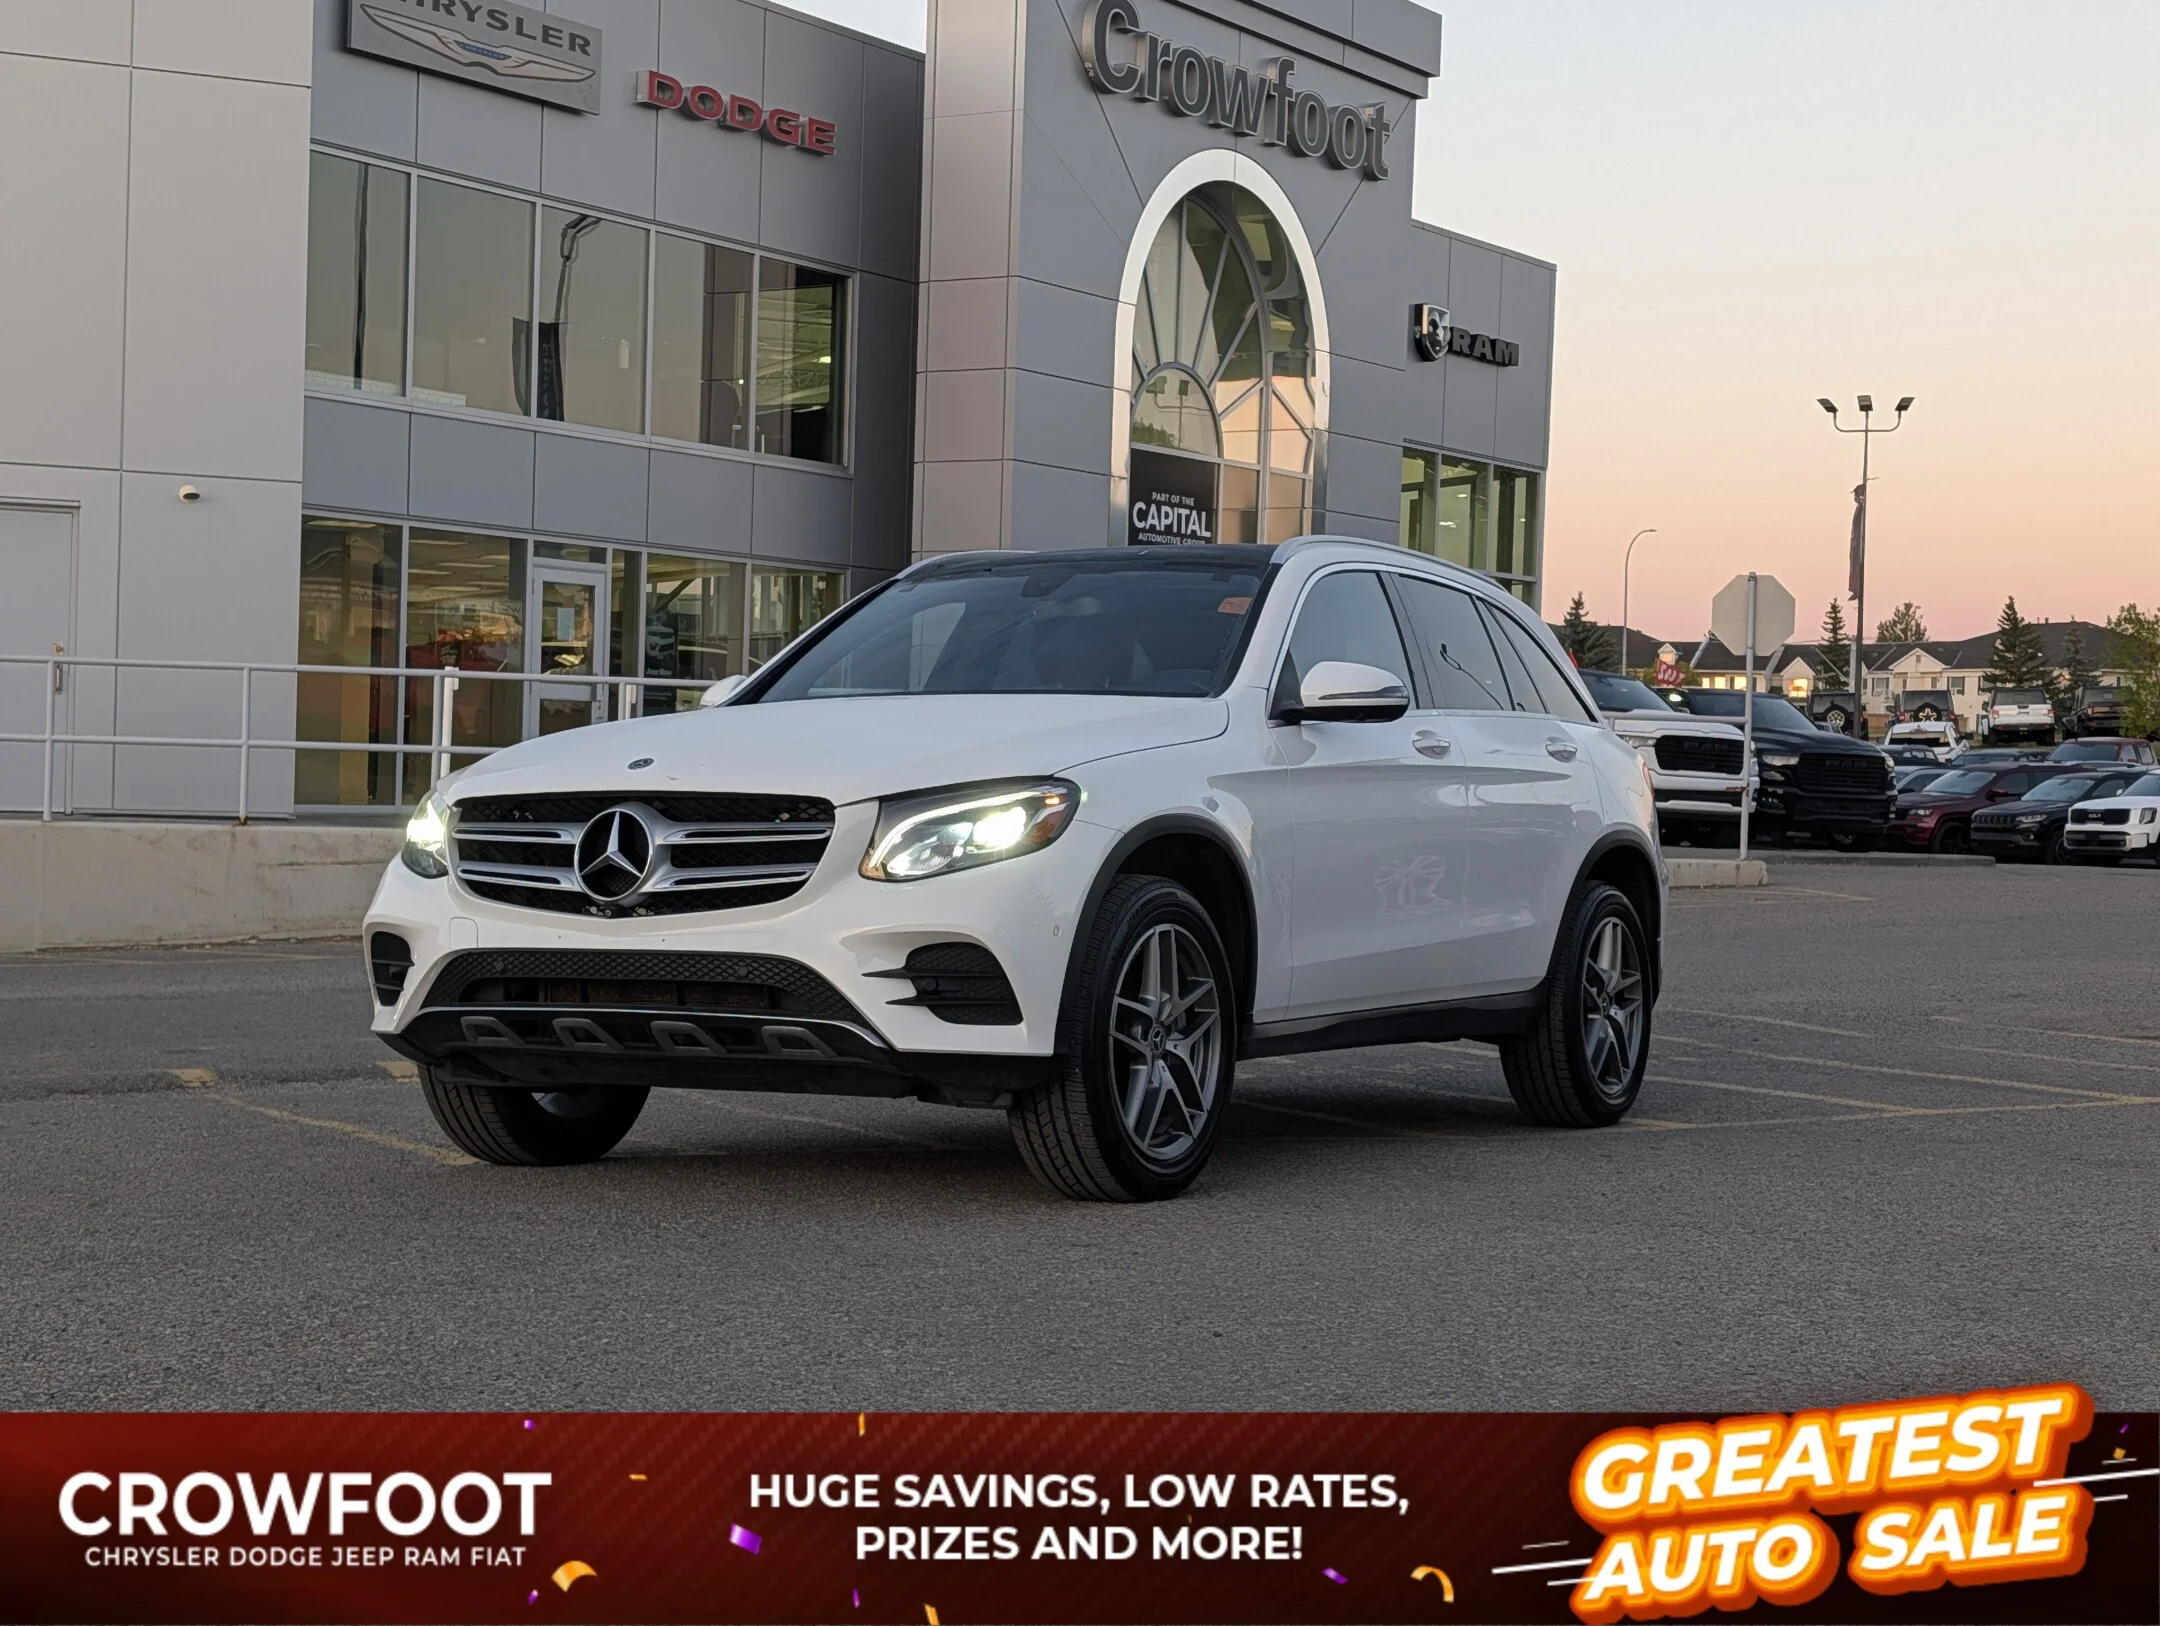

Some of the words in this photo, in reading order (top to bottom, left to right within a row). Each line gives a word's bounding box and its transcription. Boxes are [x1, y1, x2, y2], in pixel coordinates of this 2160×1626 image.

[400, 0, 591, 56] RYSLER
[1083, 0, 1391, 181] Crowfoot
[638, 69, 837, 155] DODGE
[1449, 326, 1520, 367] RAM
[1132, 501, 1212, 537] CAPITAL
[1152, 492, 1169, 502] PART
[1171, 495, 1180, 504] OF
[1182, 496, 1195, 506] THE
[1138, 533, 1181, 545] AUTOMOTIVE
